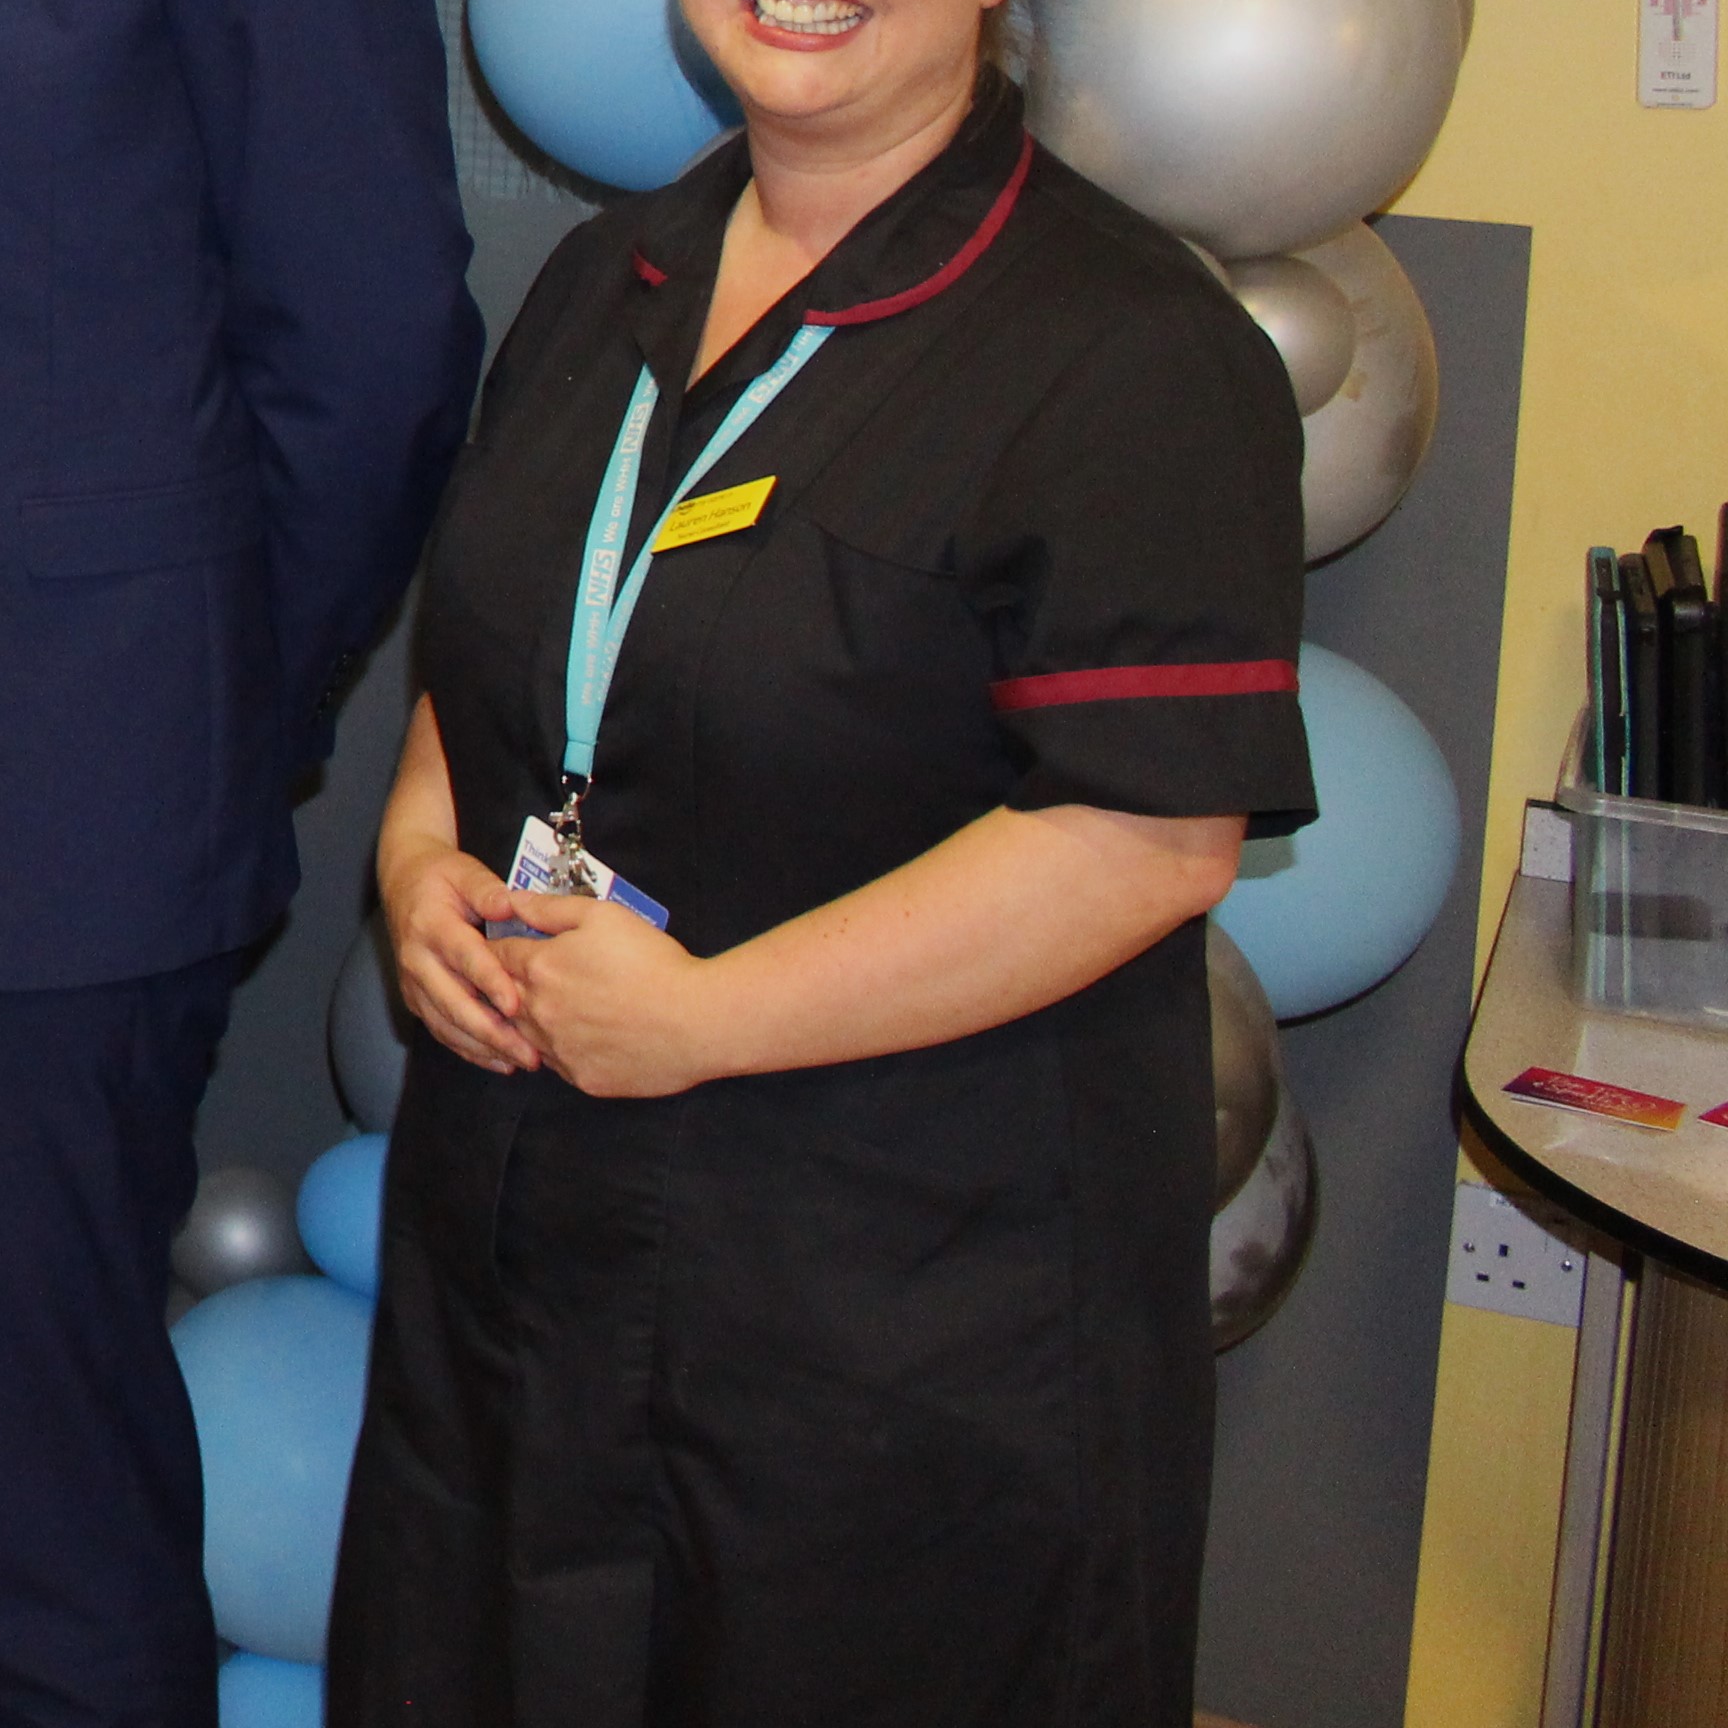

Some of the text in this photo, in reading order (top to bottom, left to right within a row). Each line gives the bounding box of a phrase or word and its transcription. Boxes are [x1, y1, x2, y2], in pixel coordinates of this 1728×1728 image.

[621, 403, 649, 453] NHS
[616, 458, 633, 493] WHH
[611, 496, 624, 518] are
[603, 522, 618, 544] We
[586, 549, 616, 606] NHS
